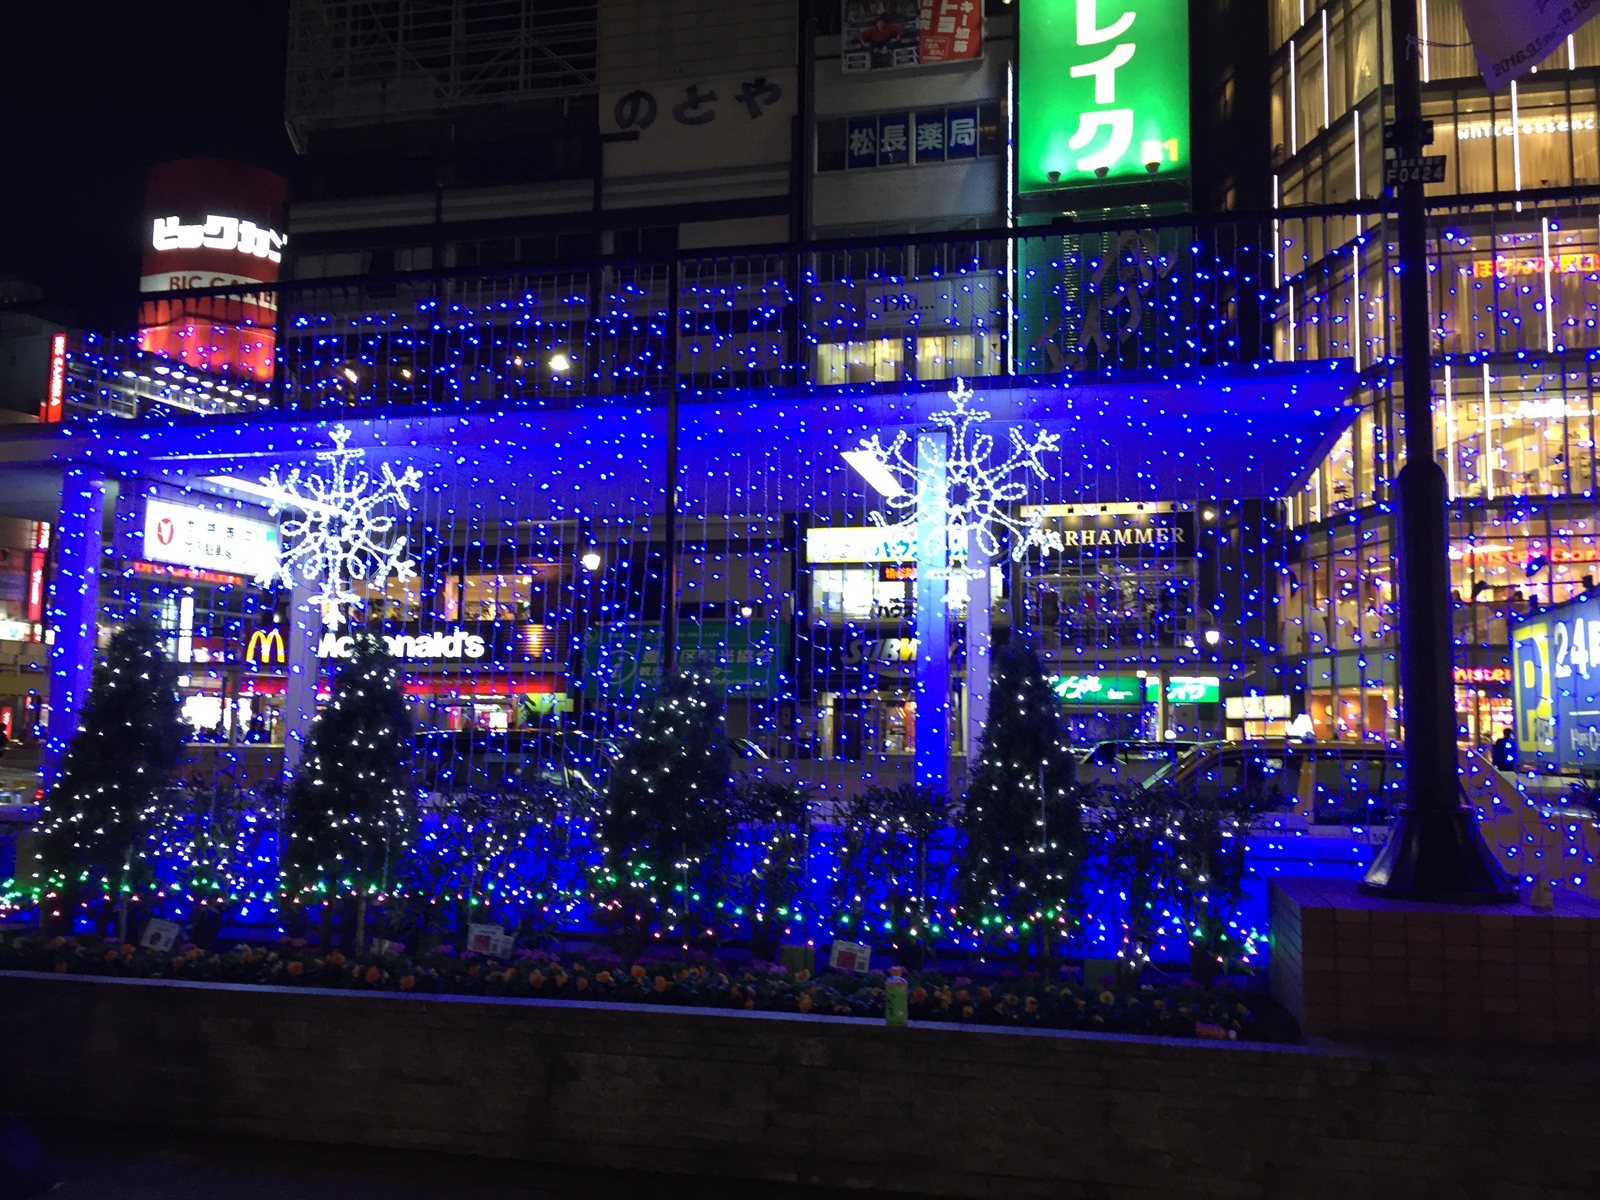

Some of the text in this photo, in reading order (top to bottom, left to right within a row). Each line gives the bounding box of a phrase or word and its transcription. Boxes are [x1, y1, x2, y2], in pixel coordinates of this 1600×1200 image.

[614, 77, 782, 129] のとや
[849, 118, 977, 157] 松長薬局
[1457, 123, 1514, 139] white
[1386, 165, 1443, 184] F0424
